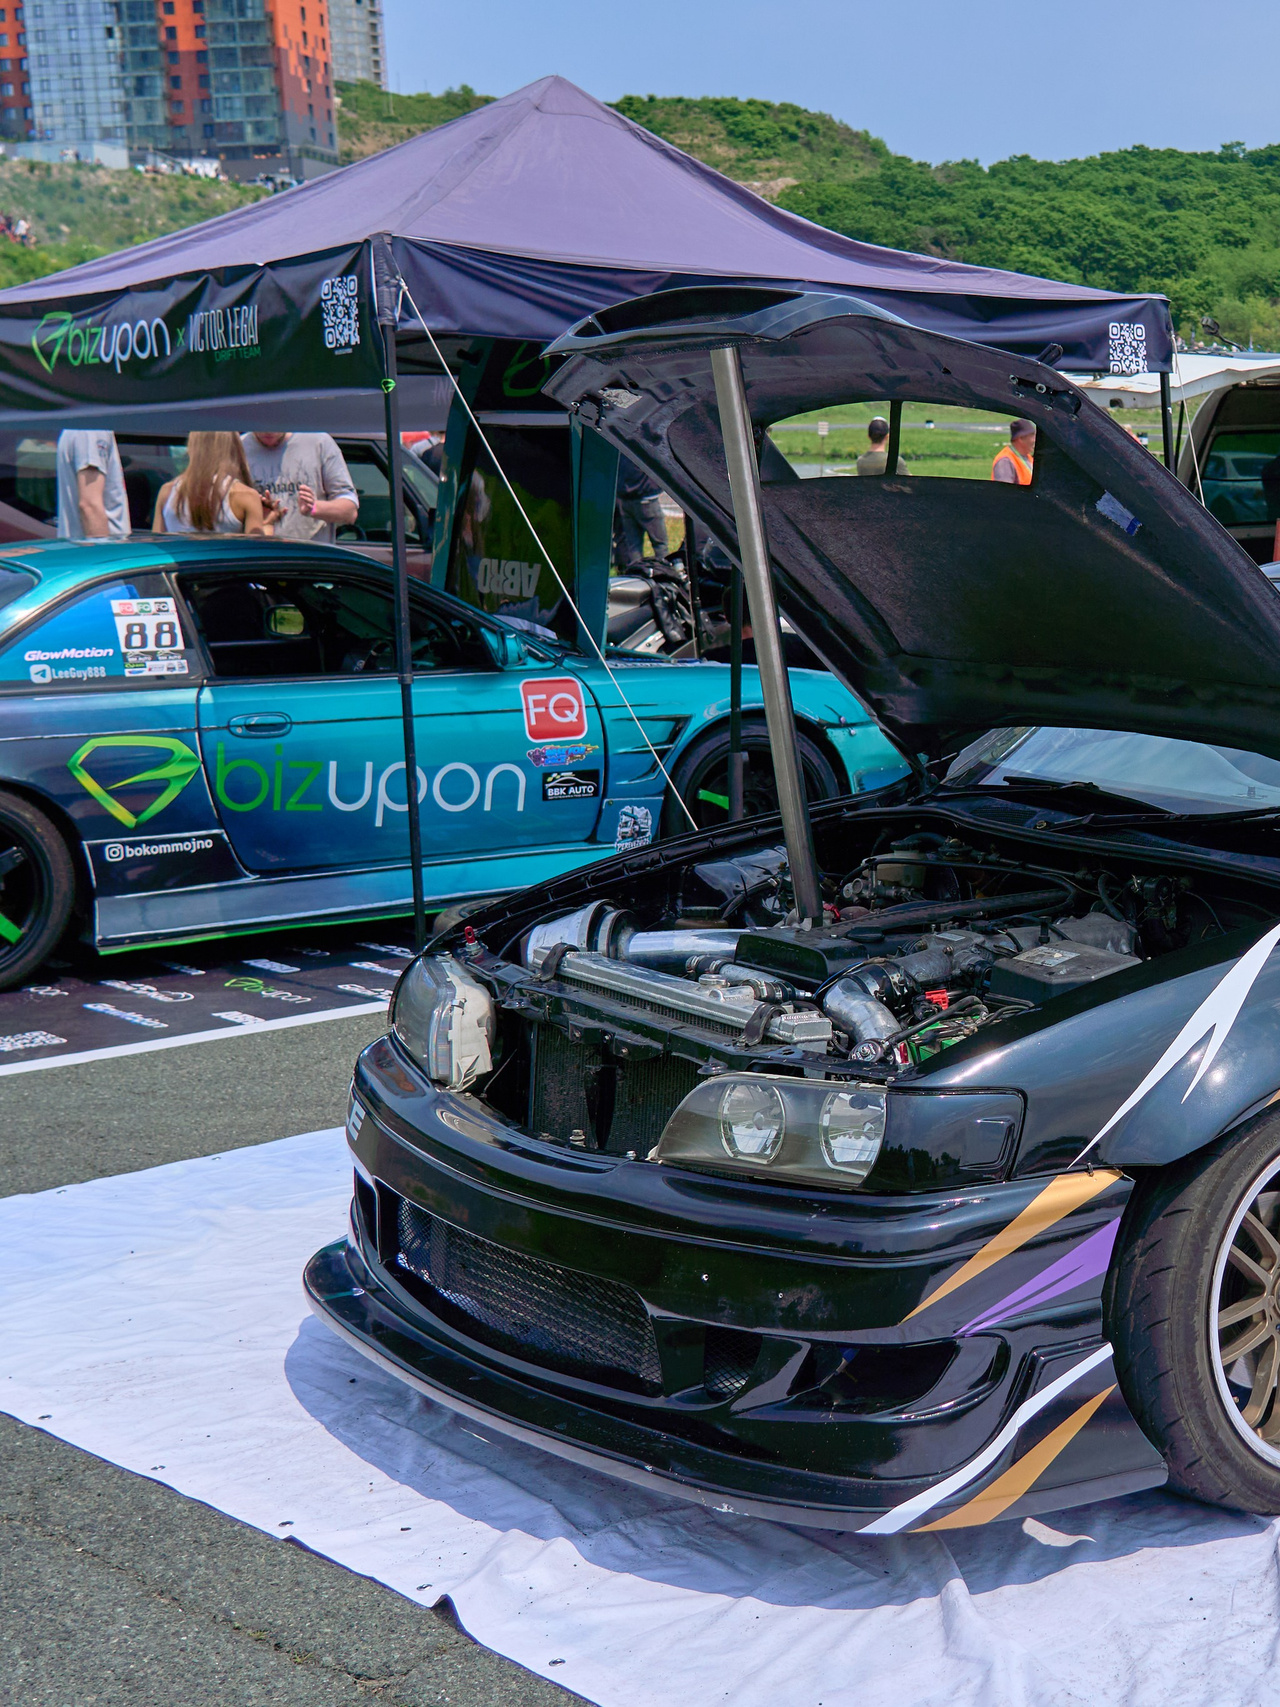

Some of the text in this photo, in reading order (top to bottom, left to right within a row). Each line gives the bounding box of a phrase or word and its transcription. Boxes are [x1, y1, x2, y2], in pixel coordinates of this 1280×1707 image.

[68, 316, 171, 374] bizupon
[189, 309, 226, 352] VICTOR
[214, 346, 261, 362] DRIFT TEAM
[124, 622, 178, 650] 88
[24, 647, 114, 662] GlowMotion
[52, 665, 107, 681] LeeGuy888
[527, 693, 580, 726] FQ
[216, 741, 527, 827] bizupon
[548, 785, 594, 796] BBK AUTO
[125, 838, 213, 858] bokommojno
